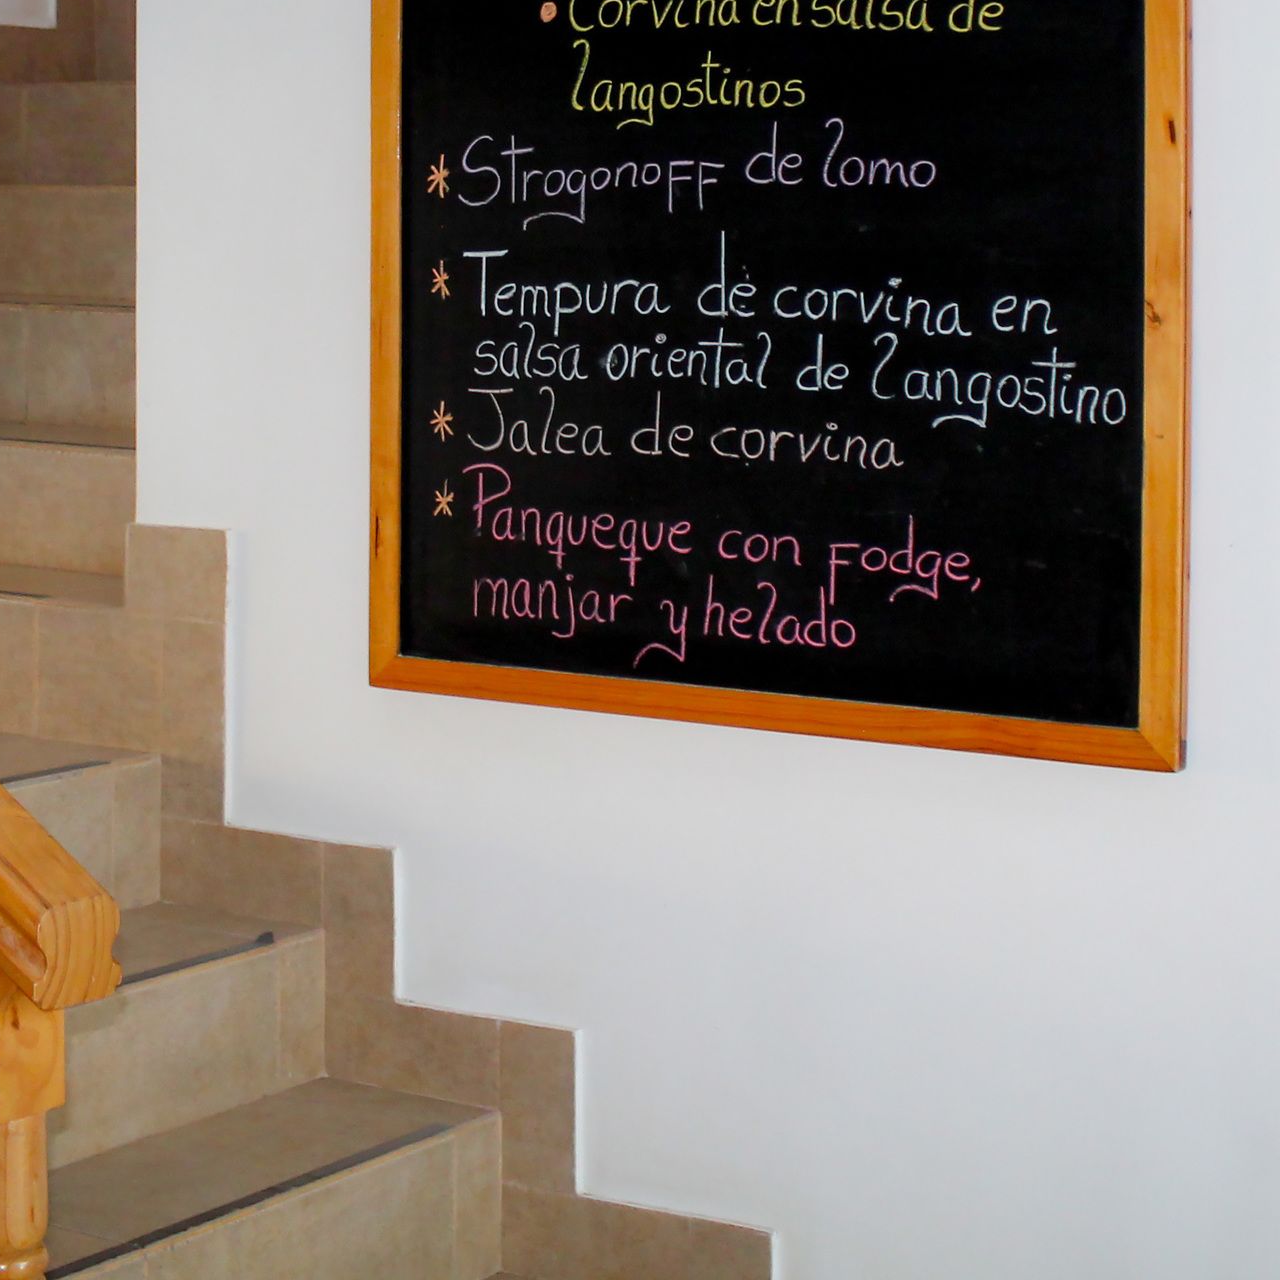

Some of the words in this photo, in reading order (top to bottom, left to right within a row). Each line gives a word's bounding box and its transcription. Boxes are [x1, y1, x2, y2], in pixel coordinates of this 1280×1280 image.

[572, 40, 805, 129] langostinos
[746, 122, 802, 184] de
[824, 118, 935, 187] lomo
[463, 250, 670, 337] Tempura
[698, 231, 756, 317] de
[774, 278, 971, 338] corvina
[992, 296, 1057, 334] en
[474, 320, 587, 380] salsa
[606, 328, 771, 388] oriental
[797, 334, 849, 391] de
[872, 330, 1126, 427] langostino
[468, 386, 611, 455] Jalea
[631, 392, 693, 457] de
[711, 423, 903, 469] corvina
[463, 464, 690, 587] Panqueque
[719, 531, 801, 565] con
[475, 577, 634, 637] manjar
[633, 601, 688, 668] y
[704, 570, 855, 647] helado
